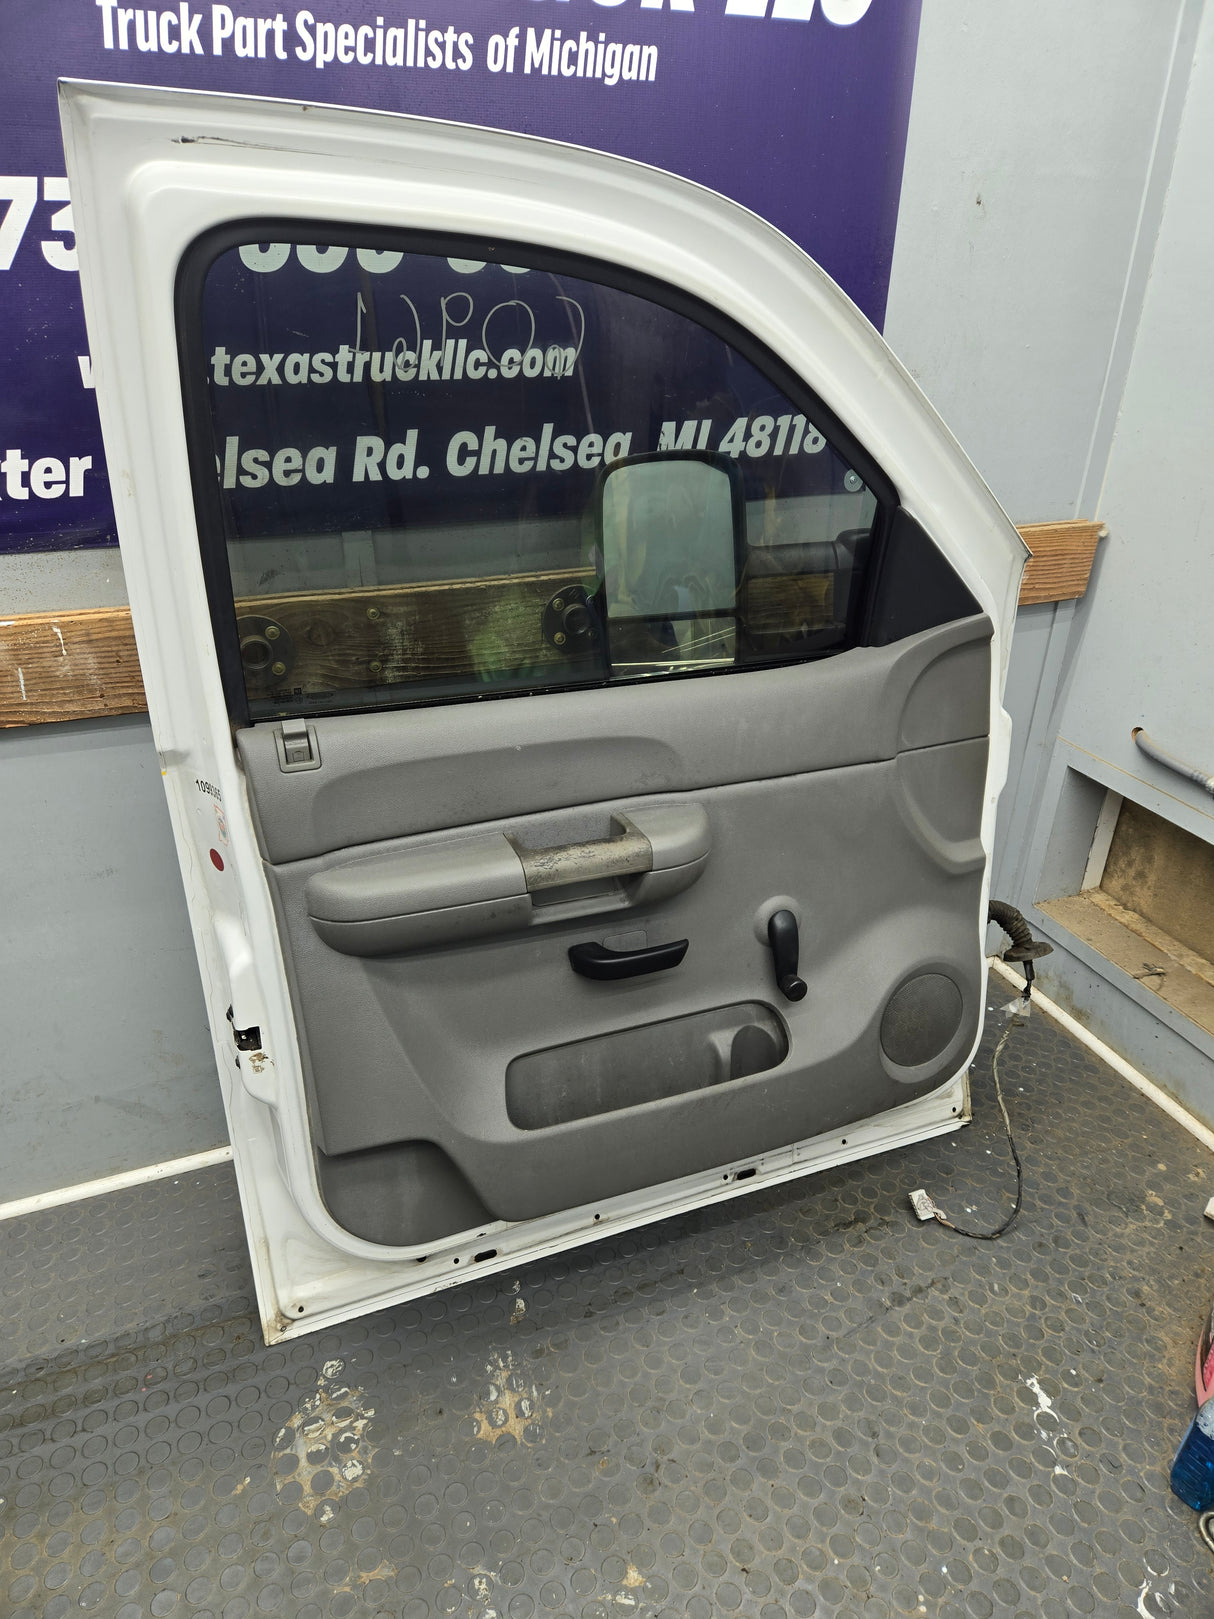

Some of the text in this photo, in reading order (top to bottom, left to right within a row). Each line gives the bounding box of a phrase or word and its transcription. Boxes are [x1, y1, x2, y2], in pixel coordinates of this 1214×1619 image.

[95, 0, 658, 86] Truck Part Specialists of Michigan
[206, 338, 577, 386] texastruckllc.com
[0, 448, 93, 500] ter
[215, 435, 338, 489] lsea
[351, 428, 431, 483] Rd.
[445, 422, 633, 478] Chelsea
[718, 413, 828, 459] 48118
